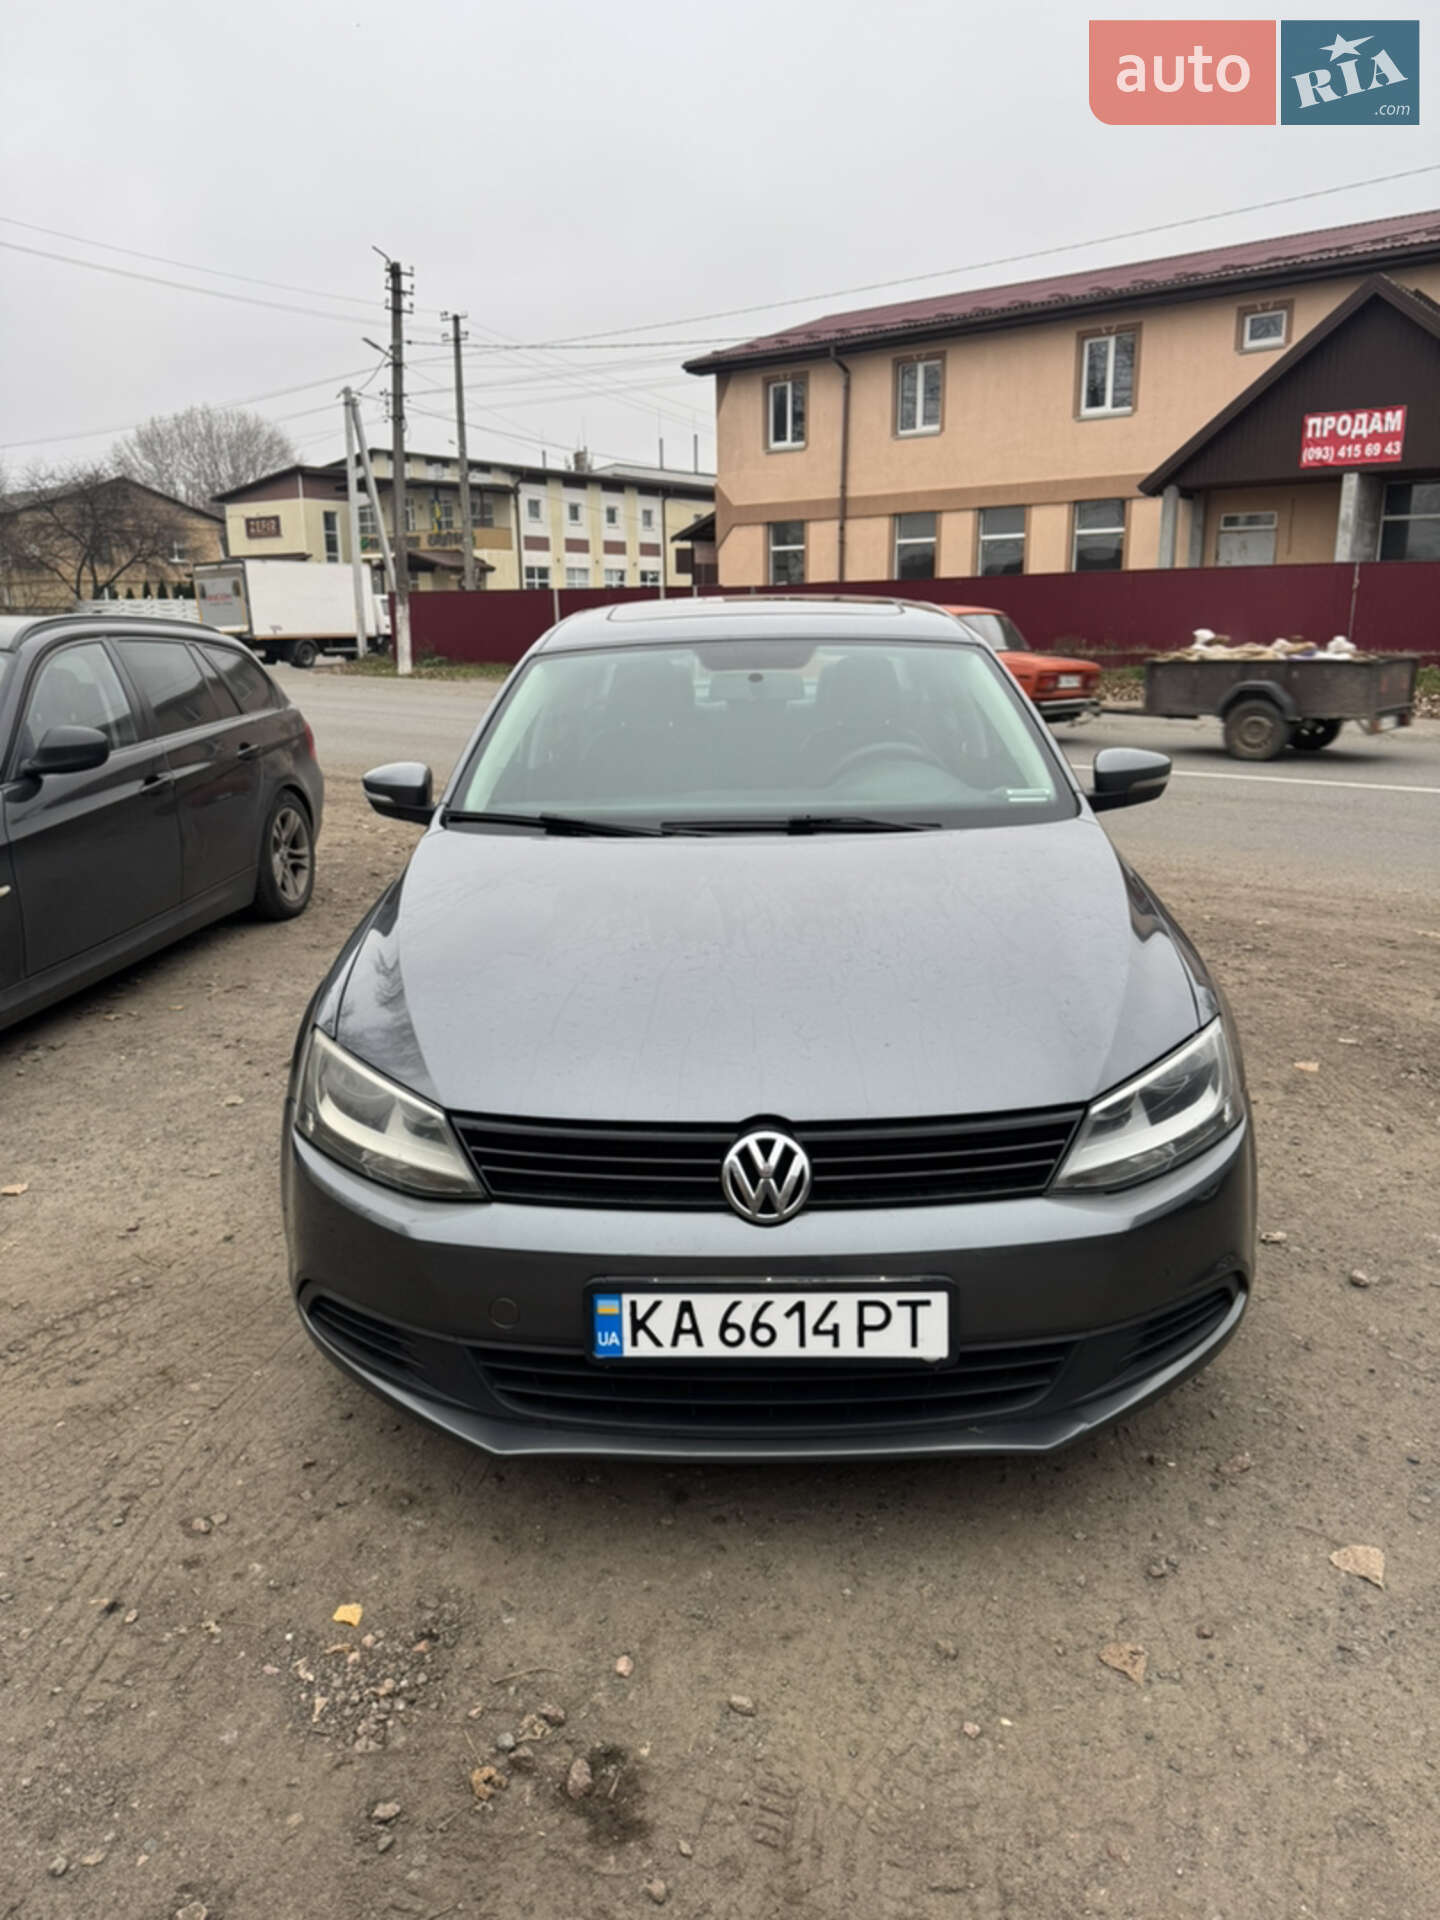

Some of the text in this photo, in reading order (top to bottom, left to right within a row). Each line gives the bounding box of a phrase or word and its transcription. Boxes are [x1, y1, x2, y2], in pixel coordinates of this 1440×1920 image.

[1306, 409, 1403, 440] ПРОДАМ
[1302, 440, 1402, 463] (093) 415 69 43
[722, 1131, 810, 1222] VW
[597, 1331, 621, 1347] UA
[629, 1299, 932, 1349] KA 6614 PT
